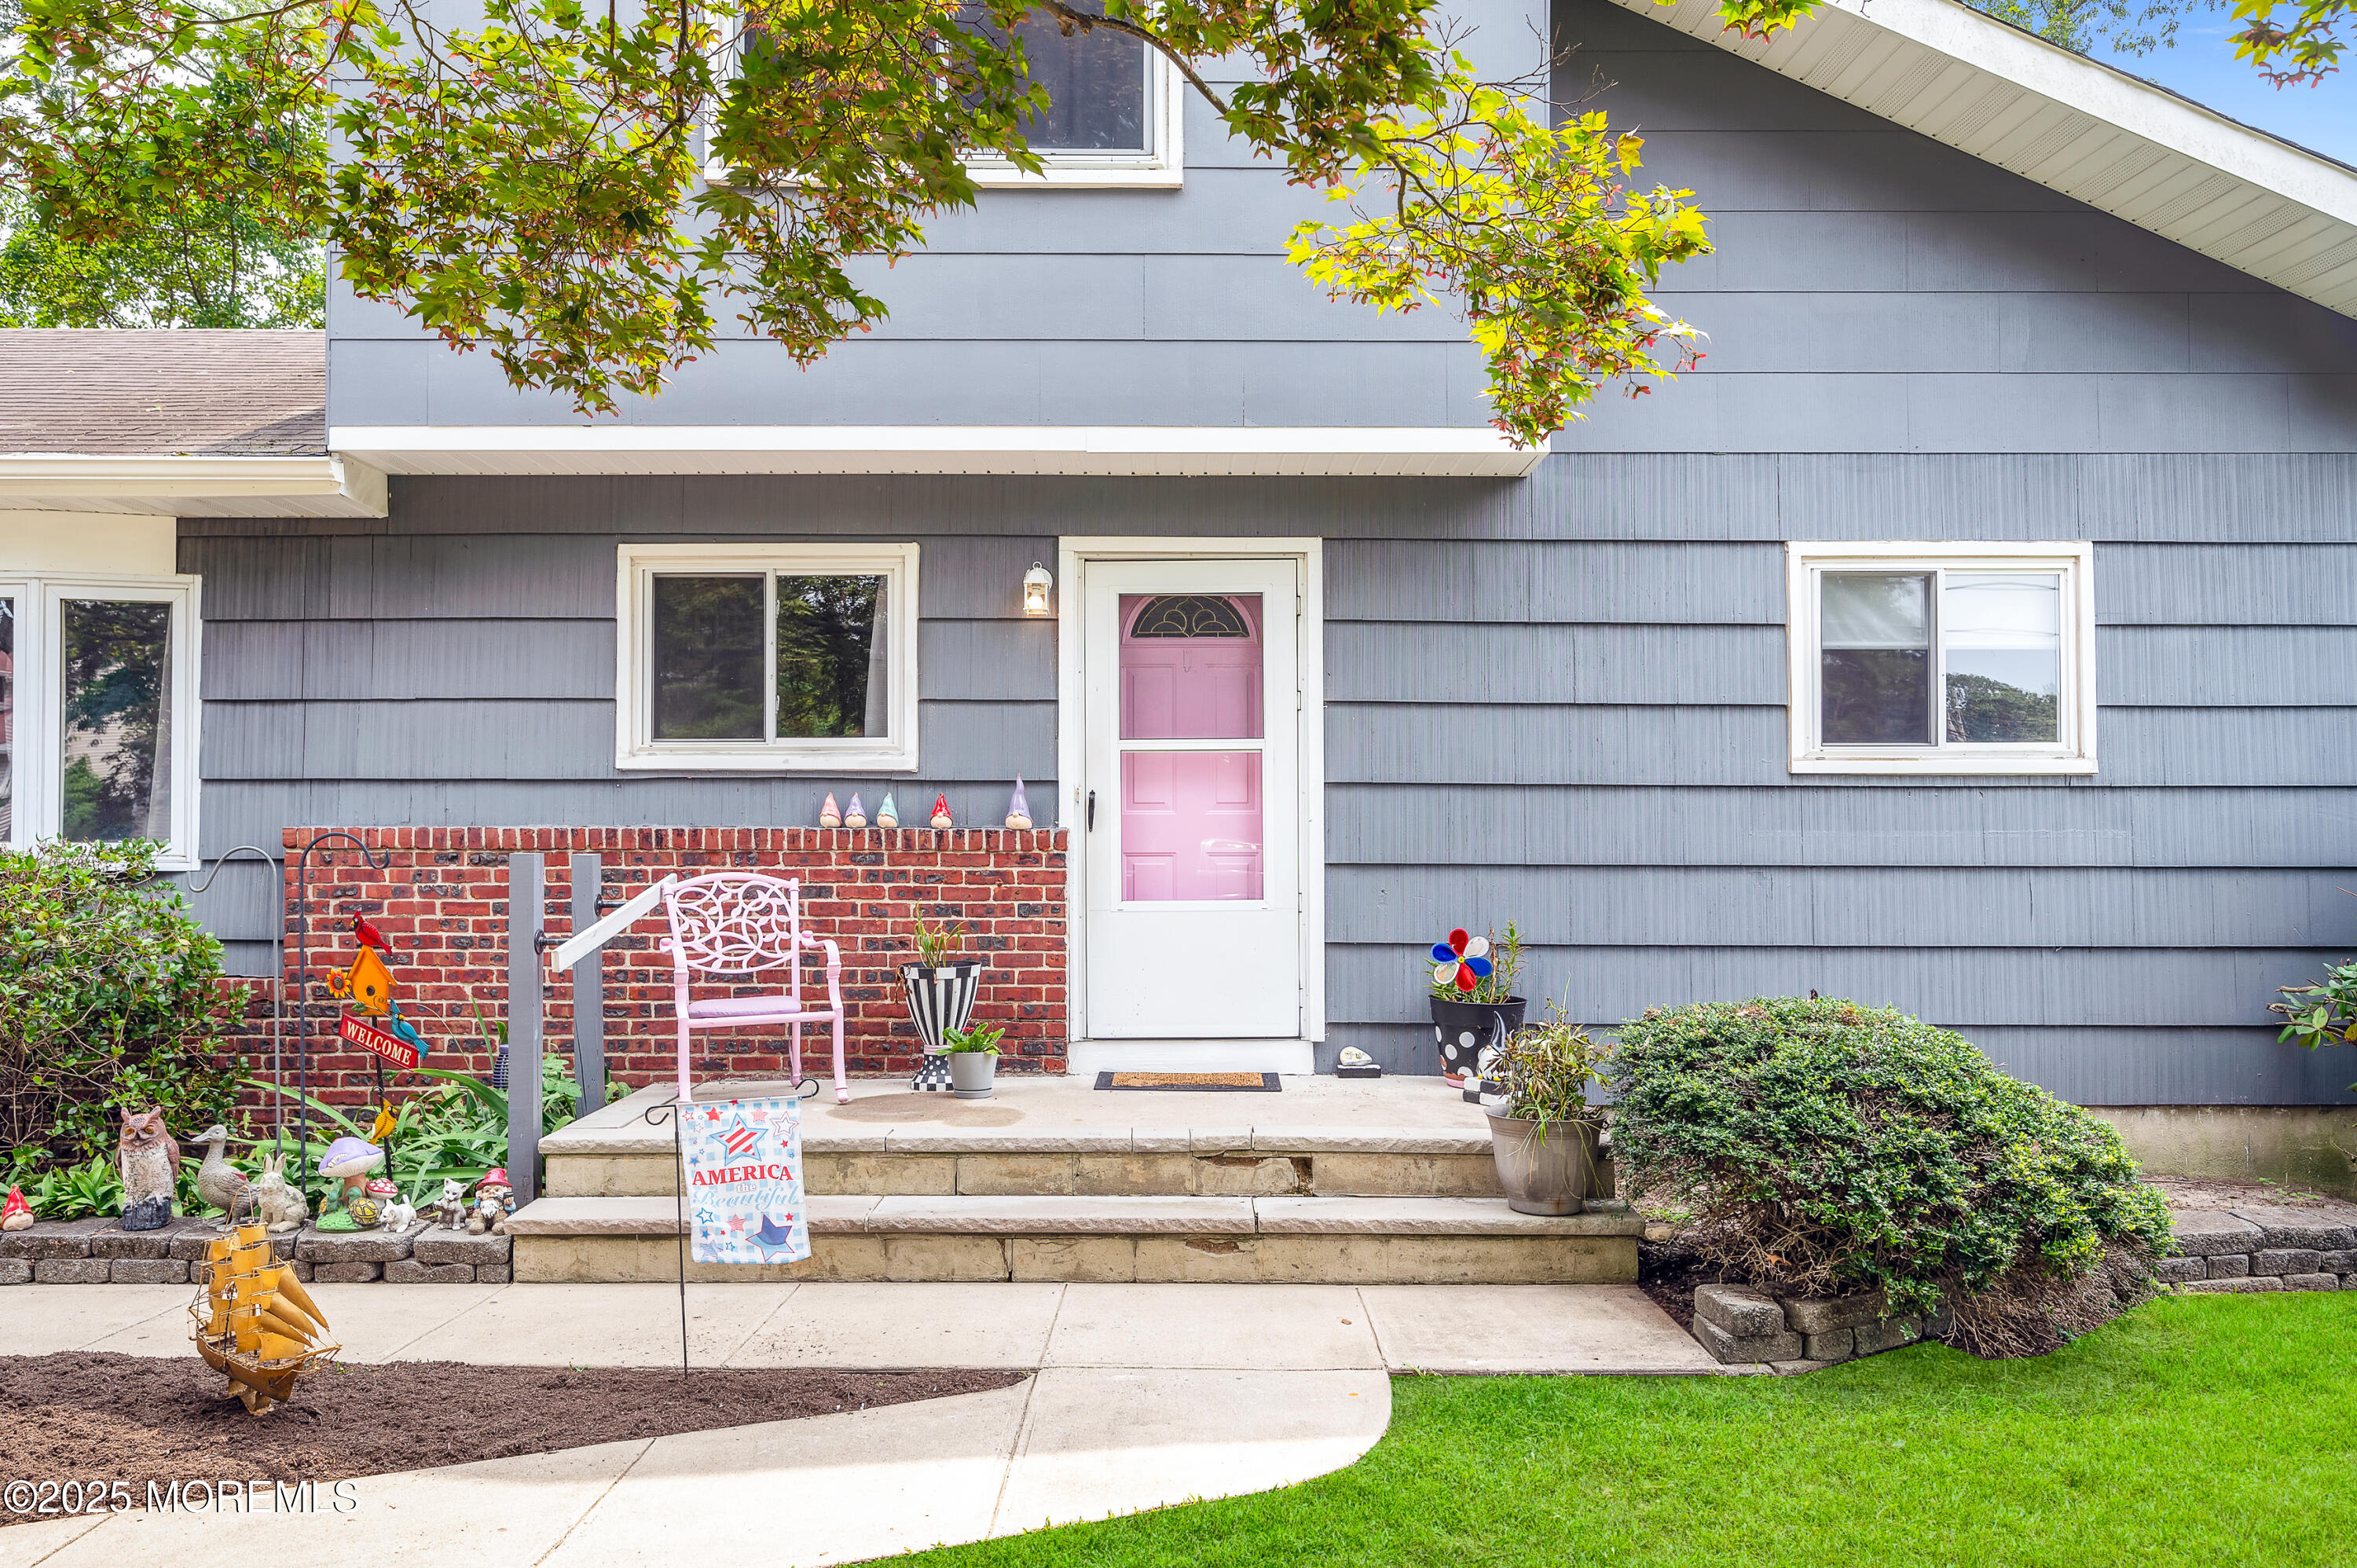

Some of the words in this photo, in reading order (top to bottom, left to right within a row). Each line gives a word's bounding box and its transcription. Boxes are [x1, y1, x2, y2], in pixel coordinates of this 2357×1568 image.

[346, 1020, 412, 1065] WELCOME
[692, 1164, 794, 1185] AMERICA
[693, 1185, 799, 1211] Beautiful
[735, 1182, 757, 1193] the
